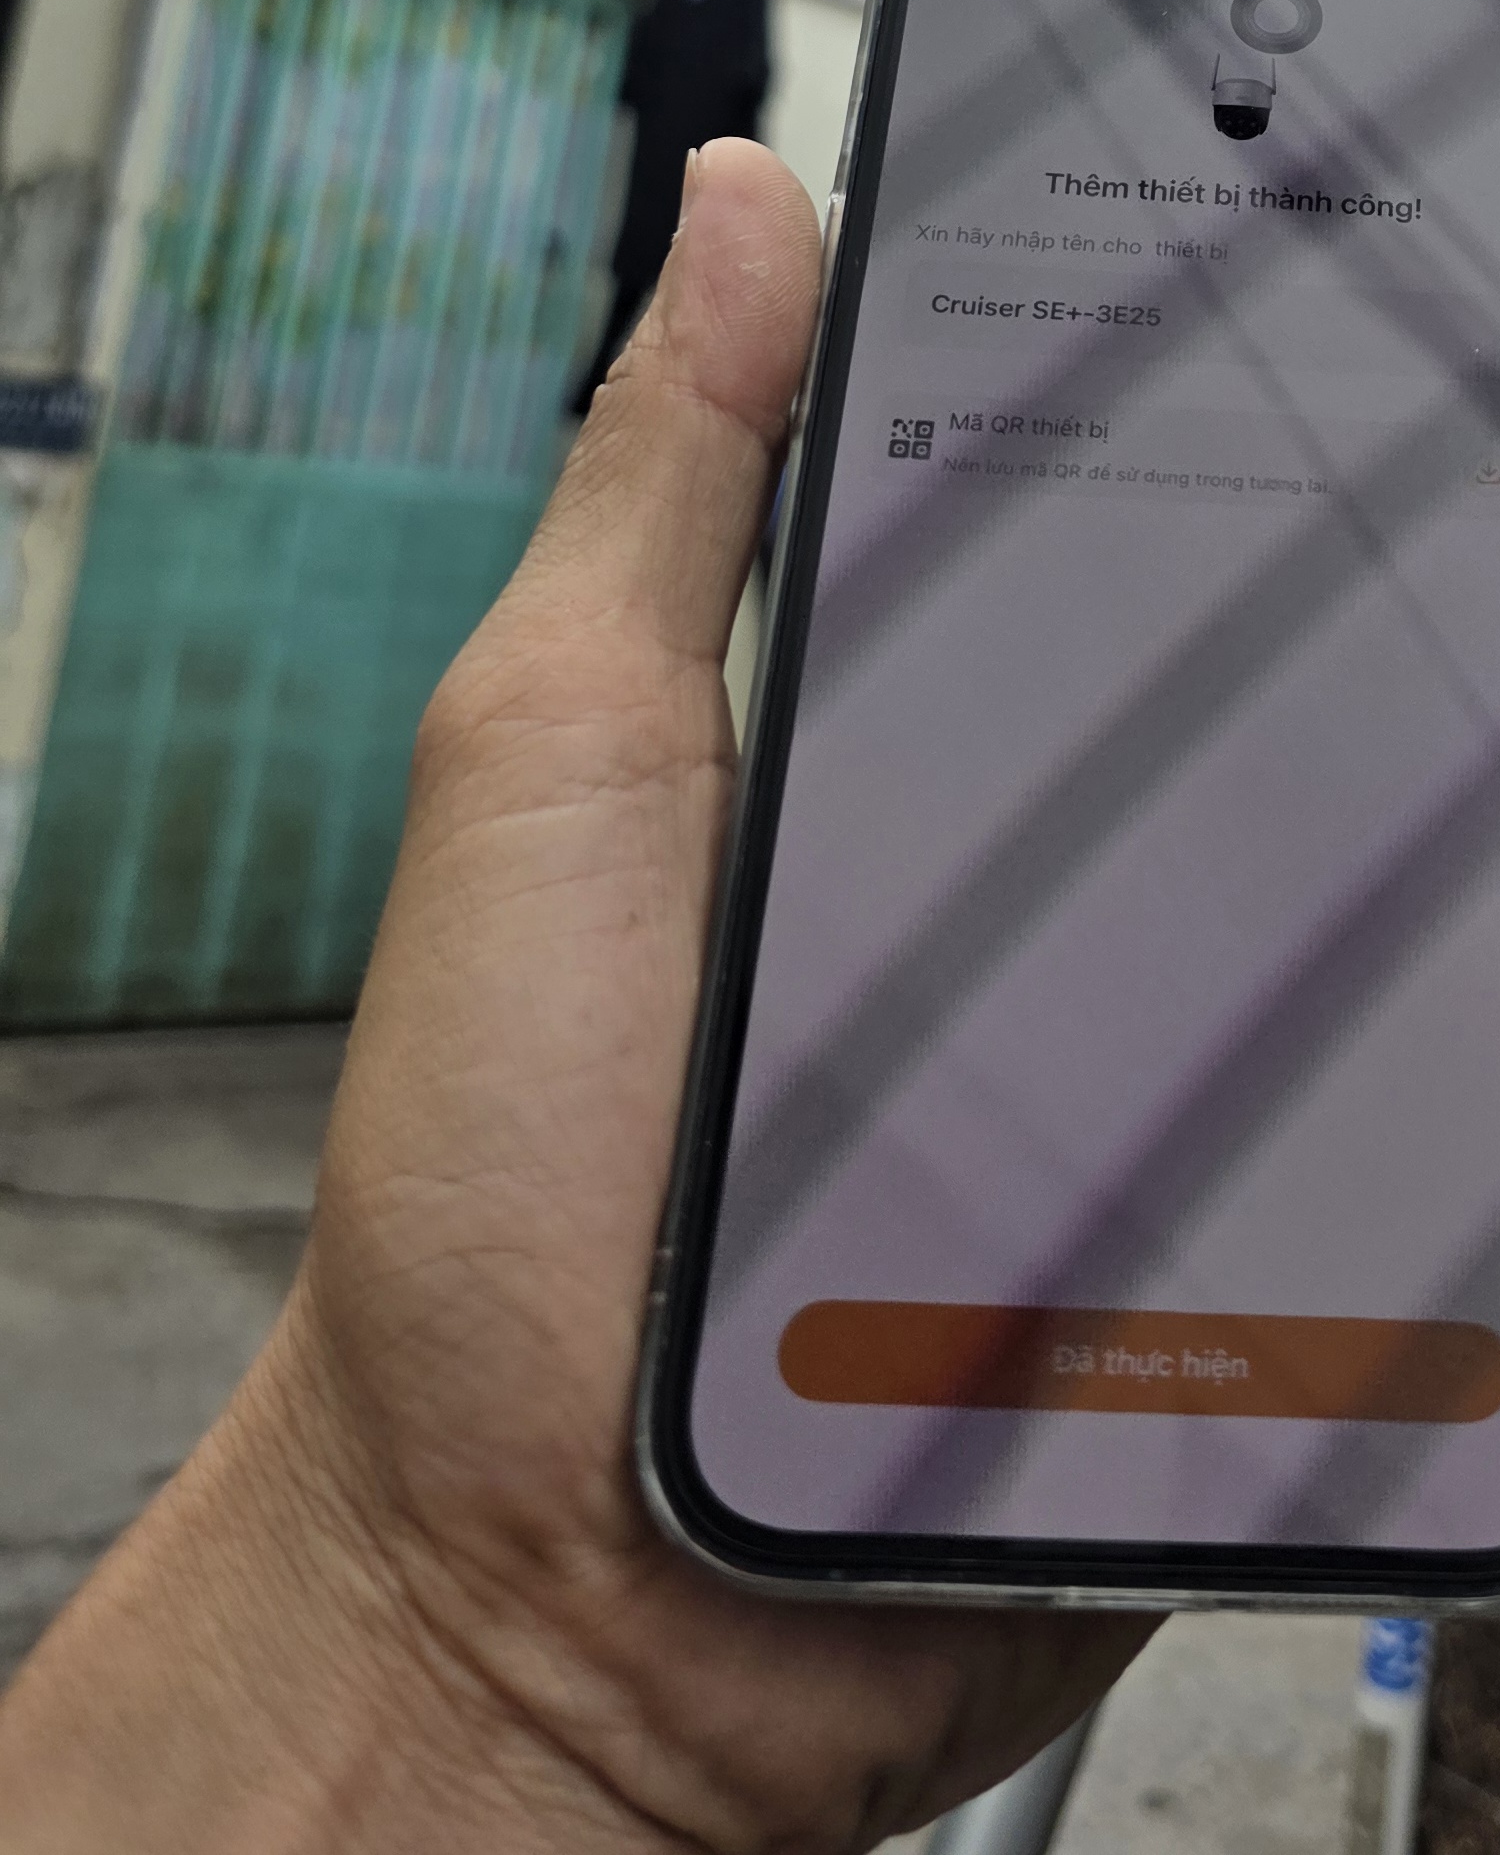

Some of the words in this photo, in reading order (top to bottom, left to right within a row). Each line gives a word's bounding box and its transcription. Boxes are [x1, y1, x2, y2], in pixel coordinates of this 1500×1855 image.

[1045, 171, 1129, 200] Thêm
[1137, 175, 1206, 205] thiết
[1214, 182, 1241, 213] bị
[1248, 185, 1332, 215] thành
[1340, 192, 1423, 224] công!
[915, 224, 949, 243] Xin
[956, 226, 996, 250] hãy
[1001, 230, 1056, 254] nhập
[1062, 233, 1096, 253] tên
[1102, 236, 1143, 256] cho
[1154, 238, 1204, 260] thiết
[1209, 243, 1229, 265] bị
[931, 294, 1026, 319] Cruiser
[1031, 299, 1163, 328] SE+-3E25
[949, 411, 984, 433] Mã
[990, 415, 1025, 436] QR
[1031, 414, 1084, 438] thiết
[1089, 420, 1110, 445] bị
[986, 458, 1015, 477] lưu
[1020, 460, 1048, 478] mã
[1053, 462, 1082, 482] QR
[1087, 461, 1112, 482] để
[1143, 467, 1190, 489] dụng
[1196, 472, 1245, 493] trong
[1102, 1345, 1176, 1384] thực
[1181, 1347, 1250, 1386] hiện
